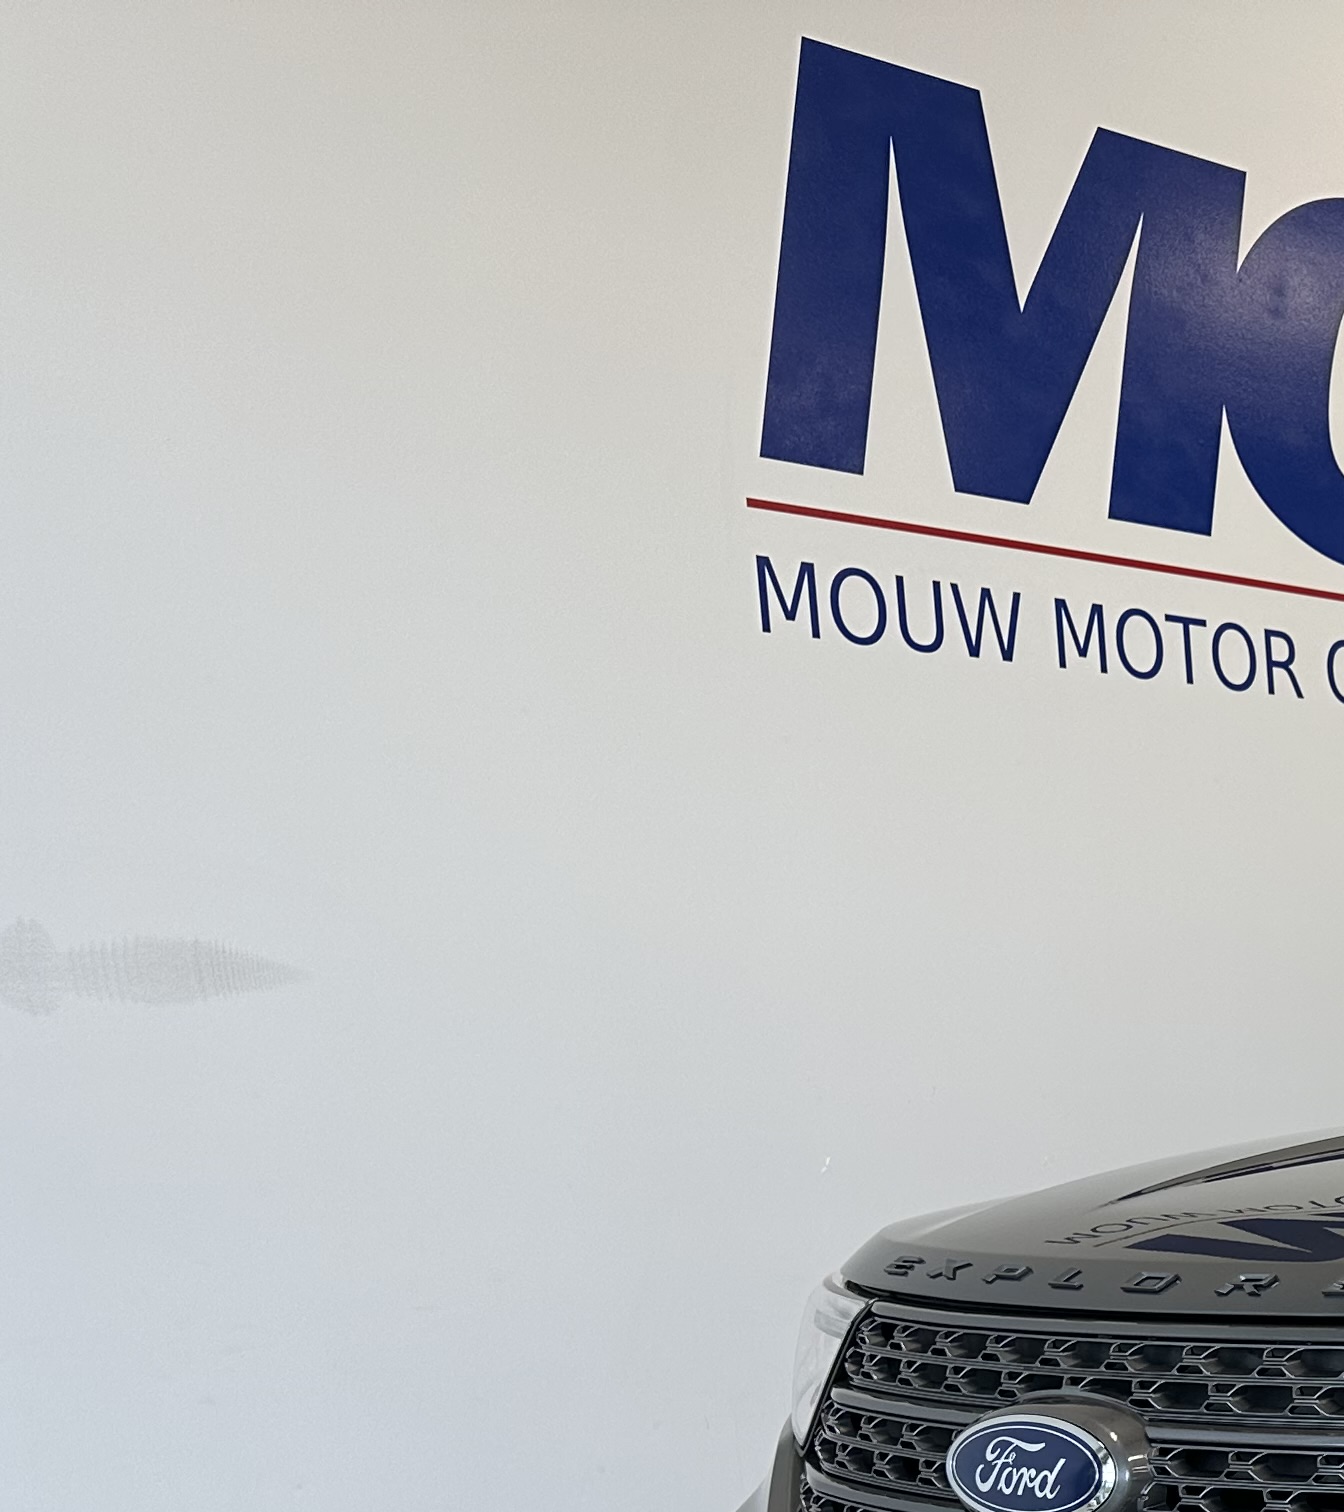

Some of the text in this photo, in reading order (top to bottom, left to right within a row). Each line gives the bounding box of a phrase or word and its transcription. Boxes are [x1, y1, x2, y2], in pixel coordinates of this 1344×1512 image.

[755, 554, 1021, 663] MOUW
[1054, 597, 1305, 699] MOTOR
[975, 1436, 1067, 1499] Ford
